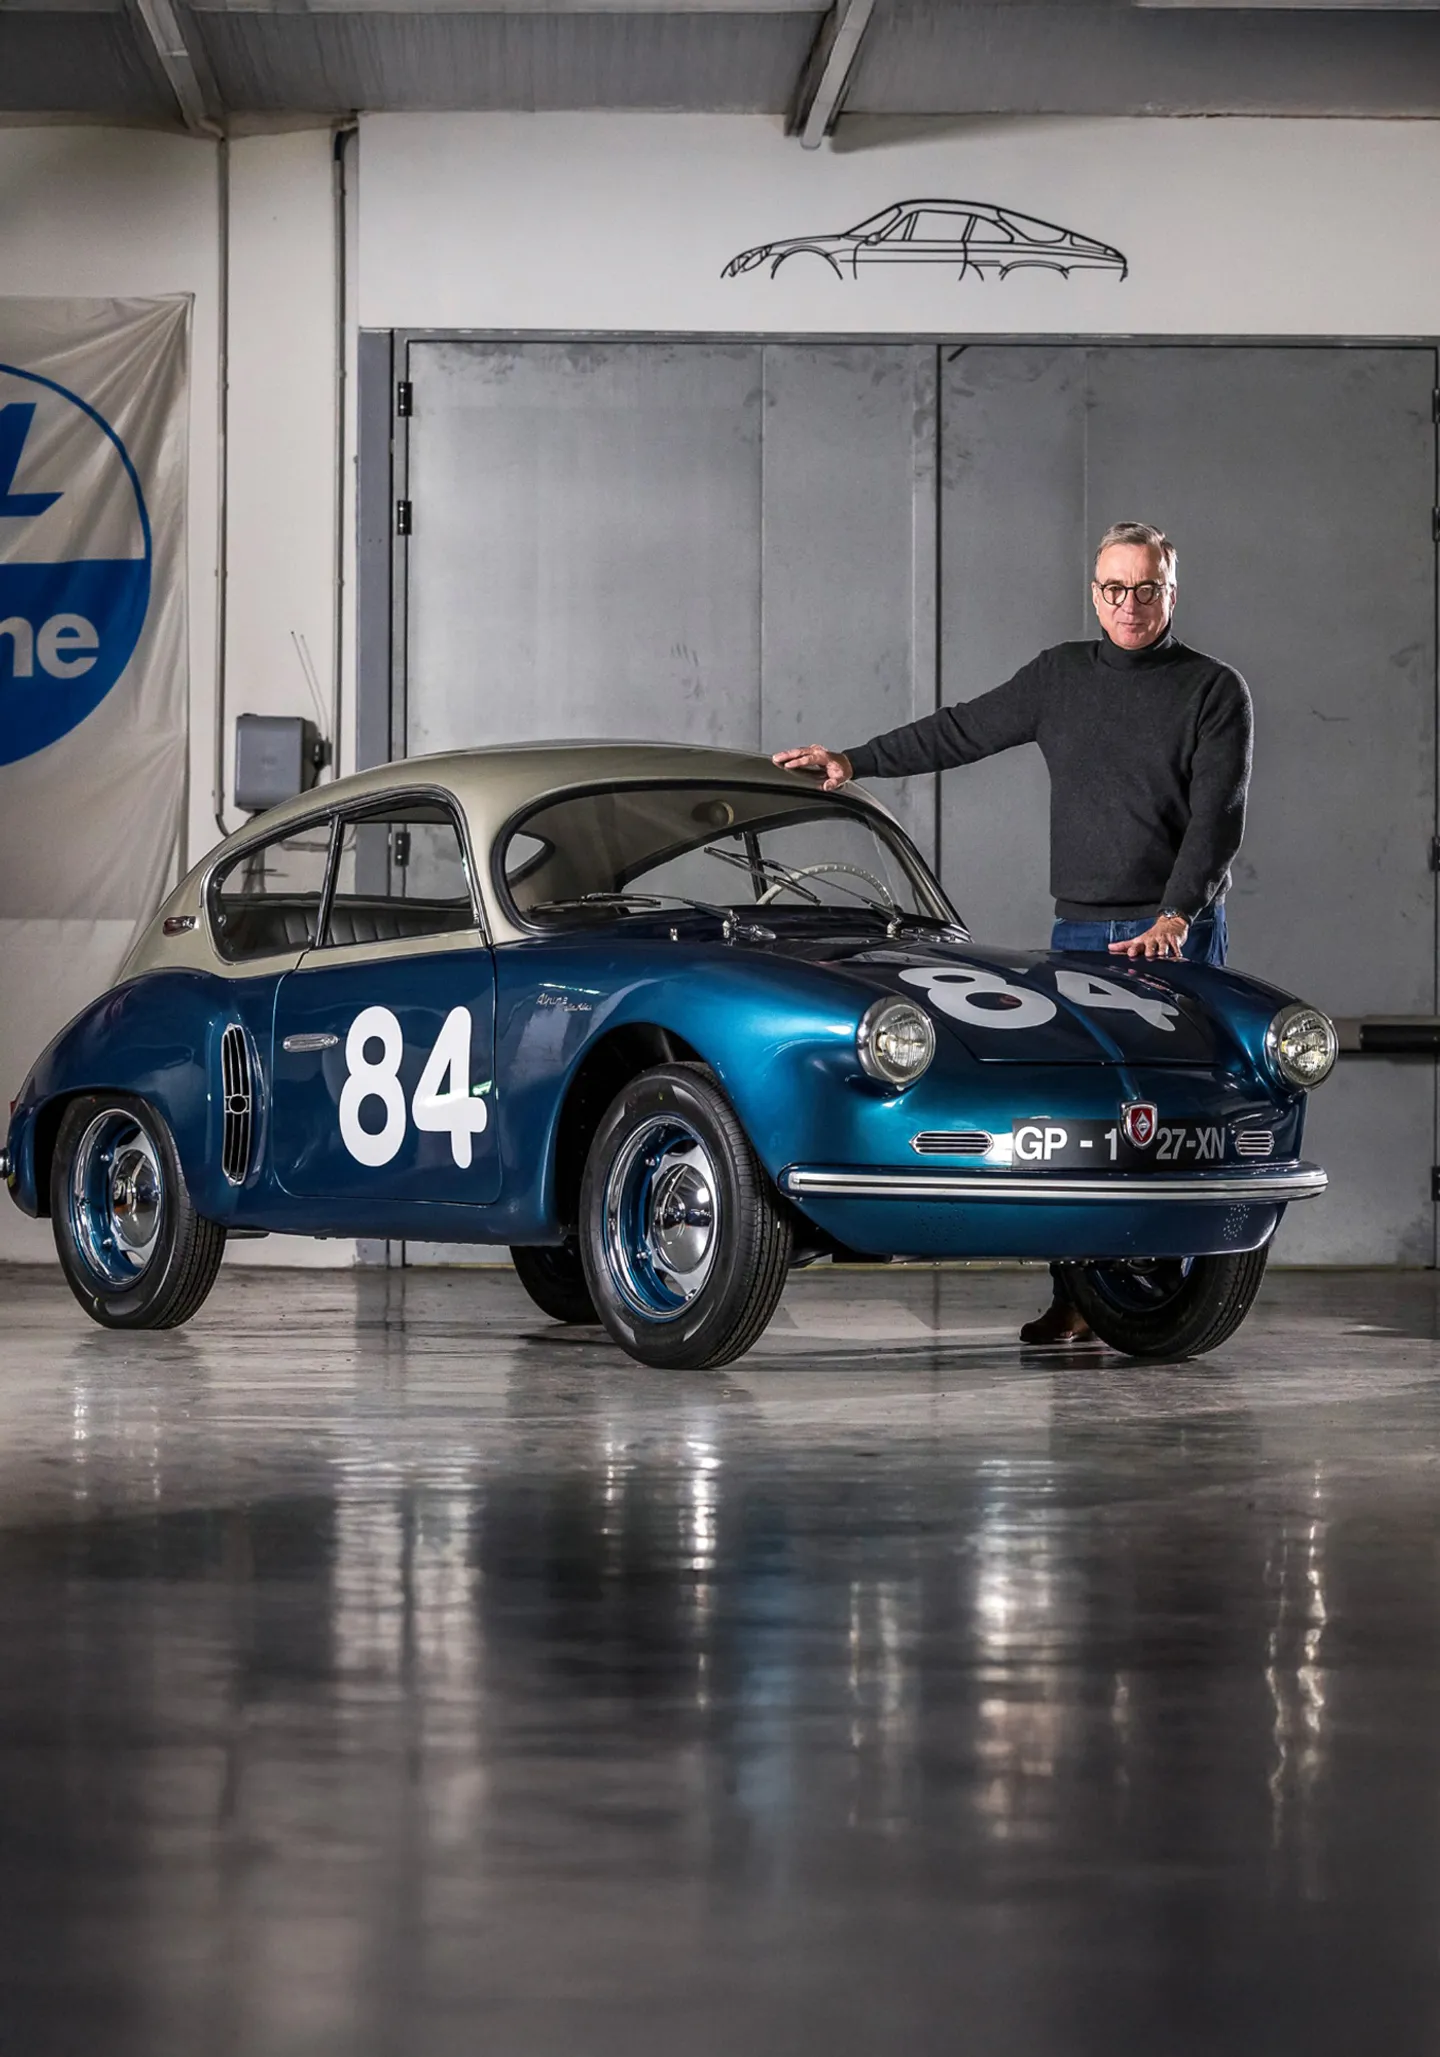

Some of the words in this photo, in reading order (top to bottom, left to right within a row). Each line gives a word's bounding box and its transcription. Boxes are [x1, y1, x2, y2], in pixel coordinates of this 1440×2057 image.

[899, 967, 1179, 1031] 84
[339, 1006, 487, 1168] 84
[1015, 1126, 1068, 1160] GP
